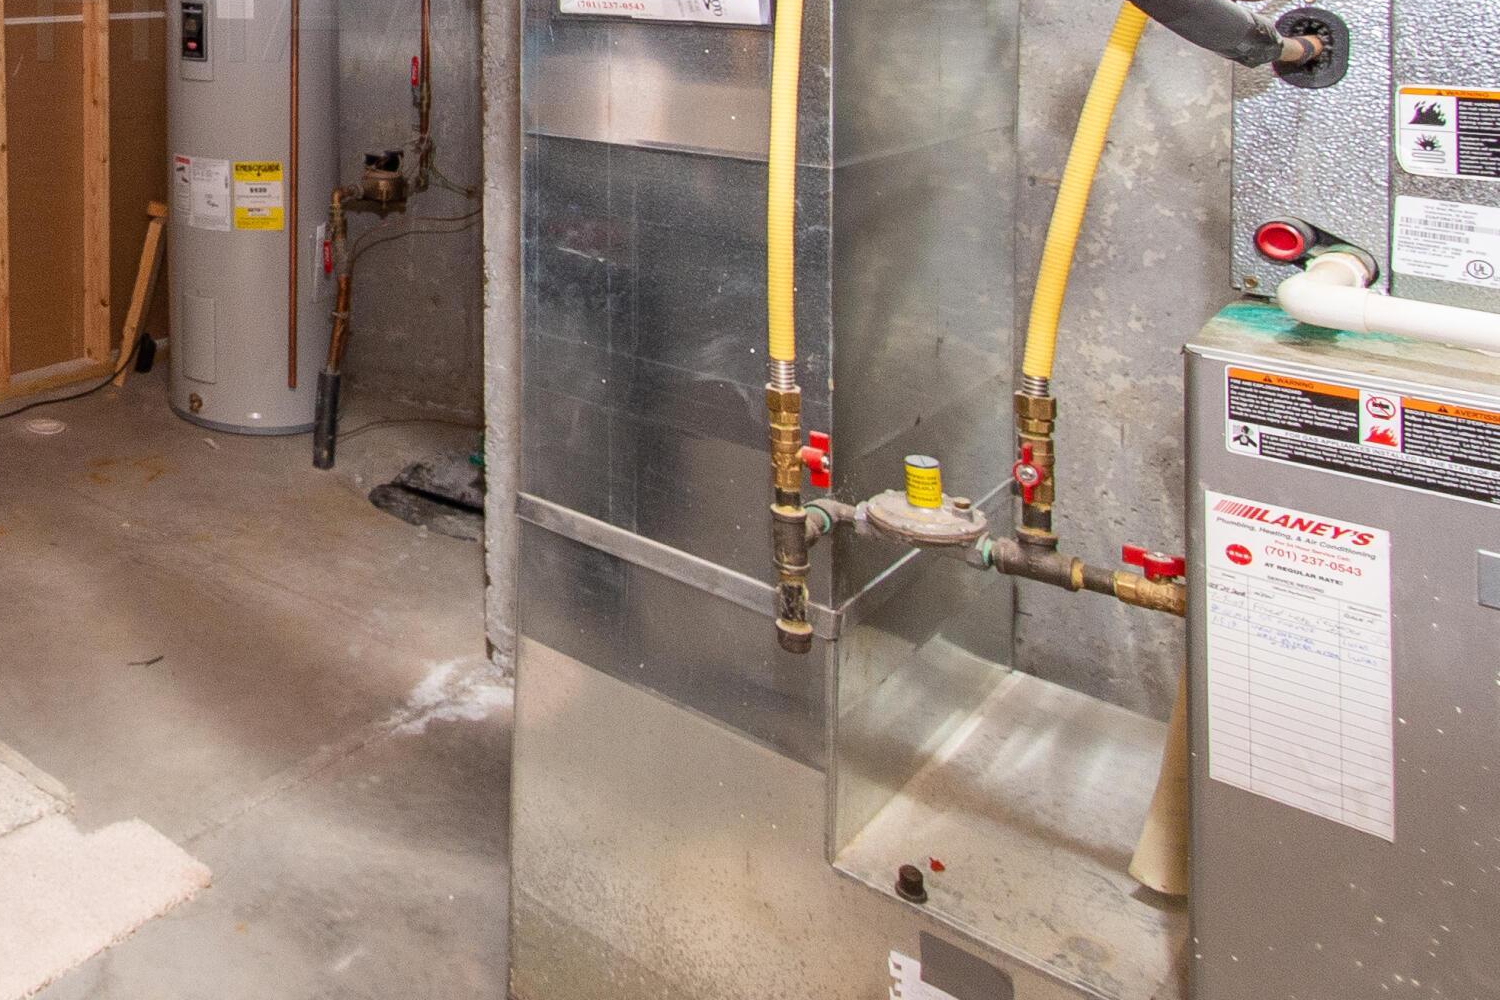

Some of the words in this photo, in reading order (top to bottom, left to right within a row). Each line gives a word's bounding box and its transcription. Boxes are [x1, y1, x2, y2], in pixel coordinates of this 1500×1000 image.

[576, 0, 600, 9] (701)
[603, 1, 646, 11] 237-0543
[1276, 377, 1315, 389] WARNING
[1284, 431, 1302, 441] FOR
[1305, 435, 1322, 444] GAS
[1323, 438, 1370, 453] APPLIANCES
[1370, 448, 1419, 462] INSTALLED
[1430, 459, 1447, 468] THE
[1448, 462, 1475, 473] STATE
[1216, 515, 1257, 533] Plumbing,
[1259, 526, 1293, 541] Heating,
[1305, 536, 1318, 545] Air
[1319, 540, 1377, 561] Conditioning
[1256, 508, 1375, 547] LANEY'S
[1264, 544, 1298, 562] (701)
[1300, 553, 1363, 578] 237-0543
[1276, 565, 1317, 580] REGULAR
[1267, 574, 1295, 587] SERVICE
[1296, 582, 1325, 594] RECORD
